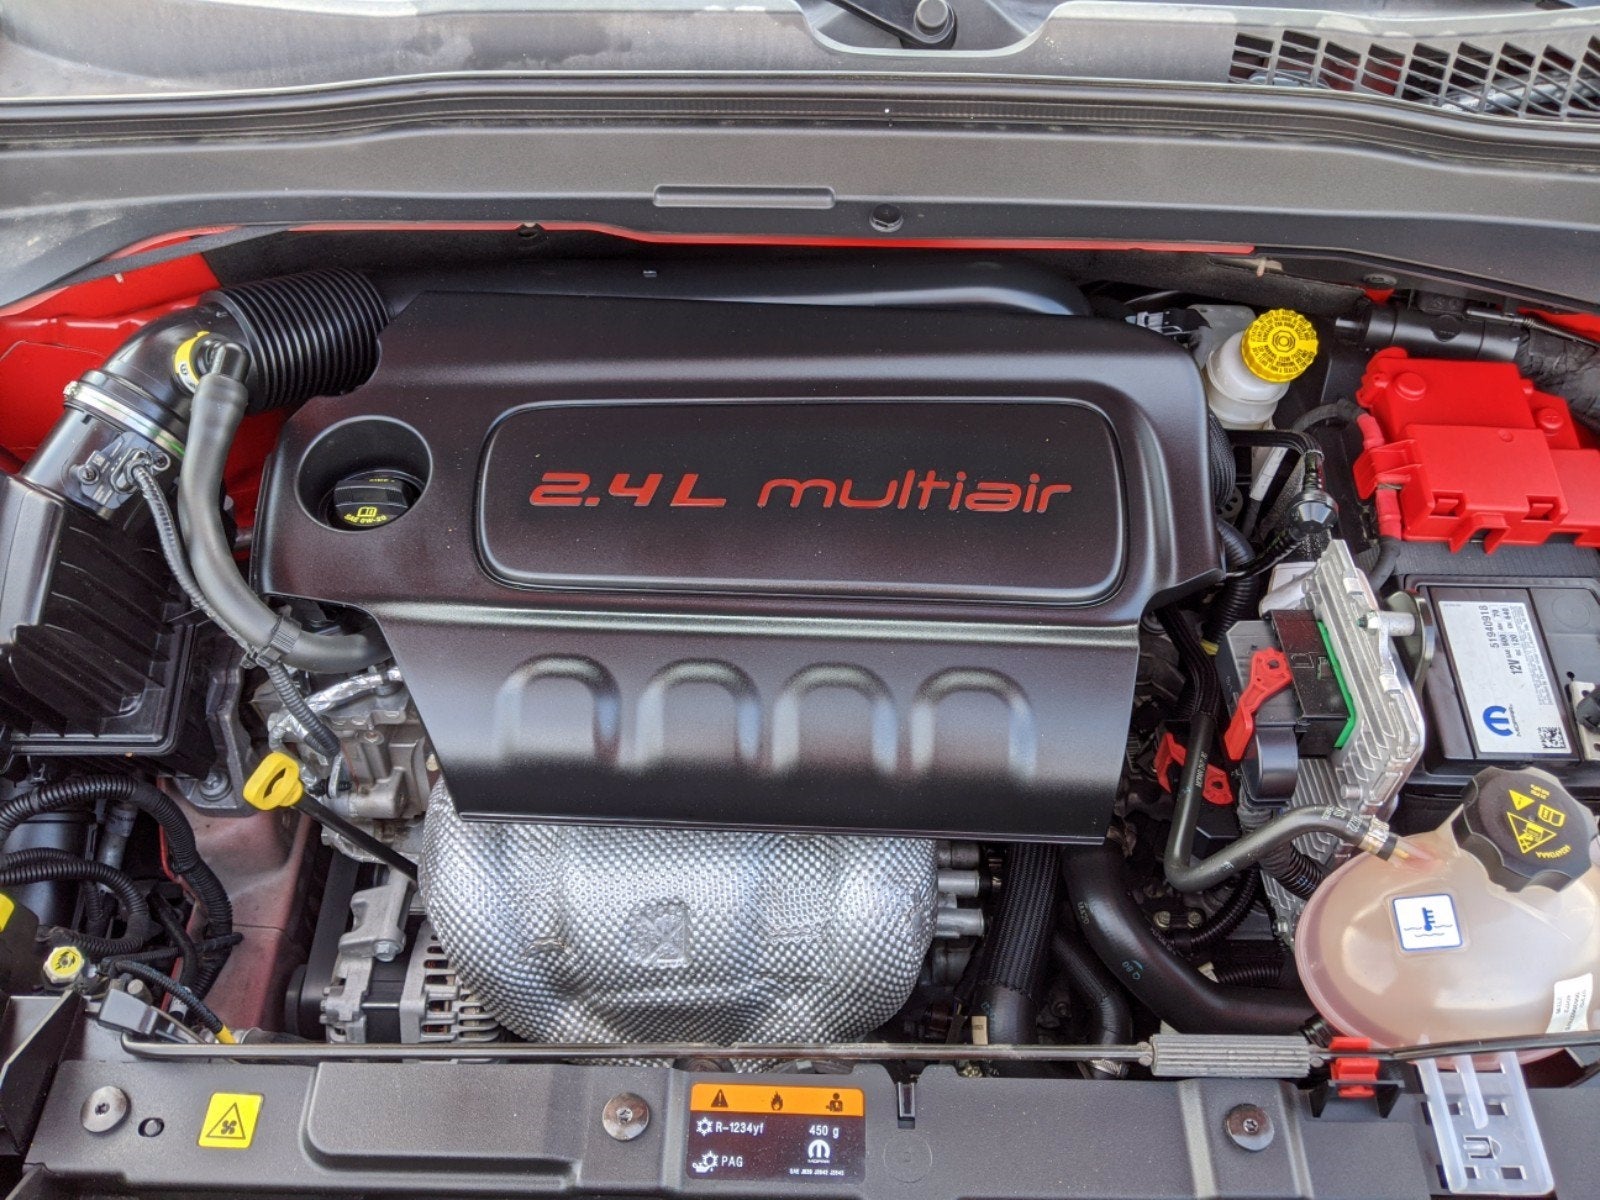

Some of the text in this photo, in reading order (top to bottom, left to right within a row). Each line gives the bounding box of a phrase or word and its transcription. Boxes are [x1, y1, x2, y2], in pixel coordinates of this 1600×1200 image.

[756, 468, 1073, 513] multiair
[1478, 605, 1500, 648] 51940918
[1507, 659, 1523, 674] 12V
[715, 1122, 840, 1139] R-1234yf 450 g
[721, 1156, 744, 1168] PAG
